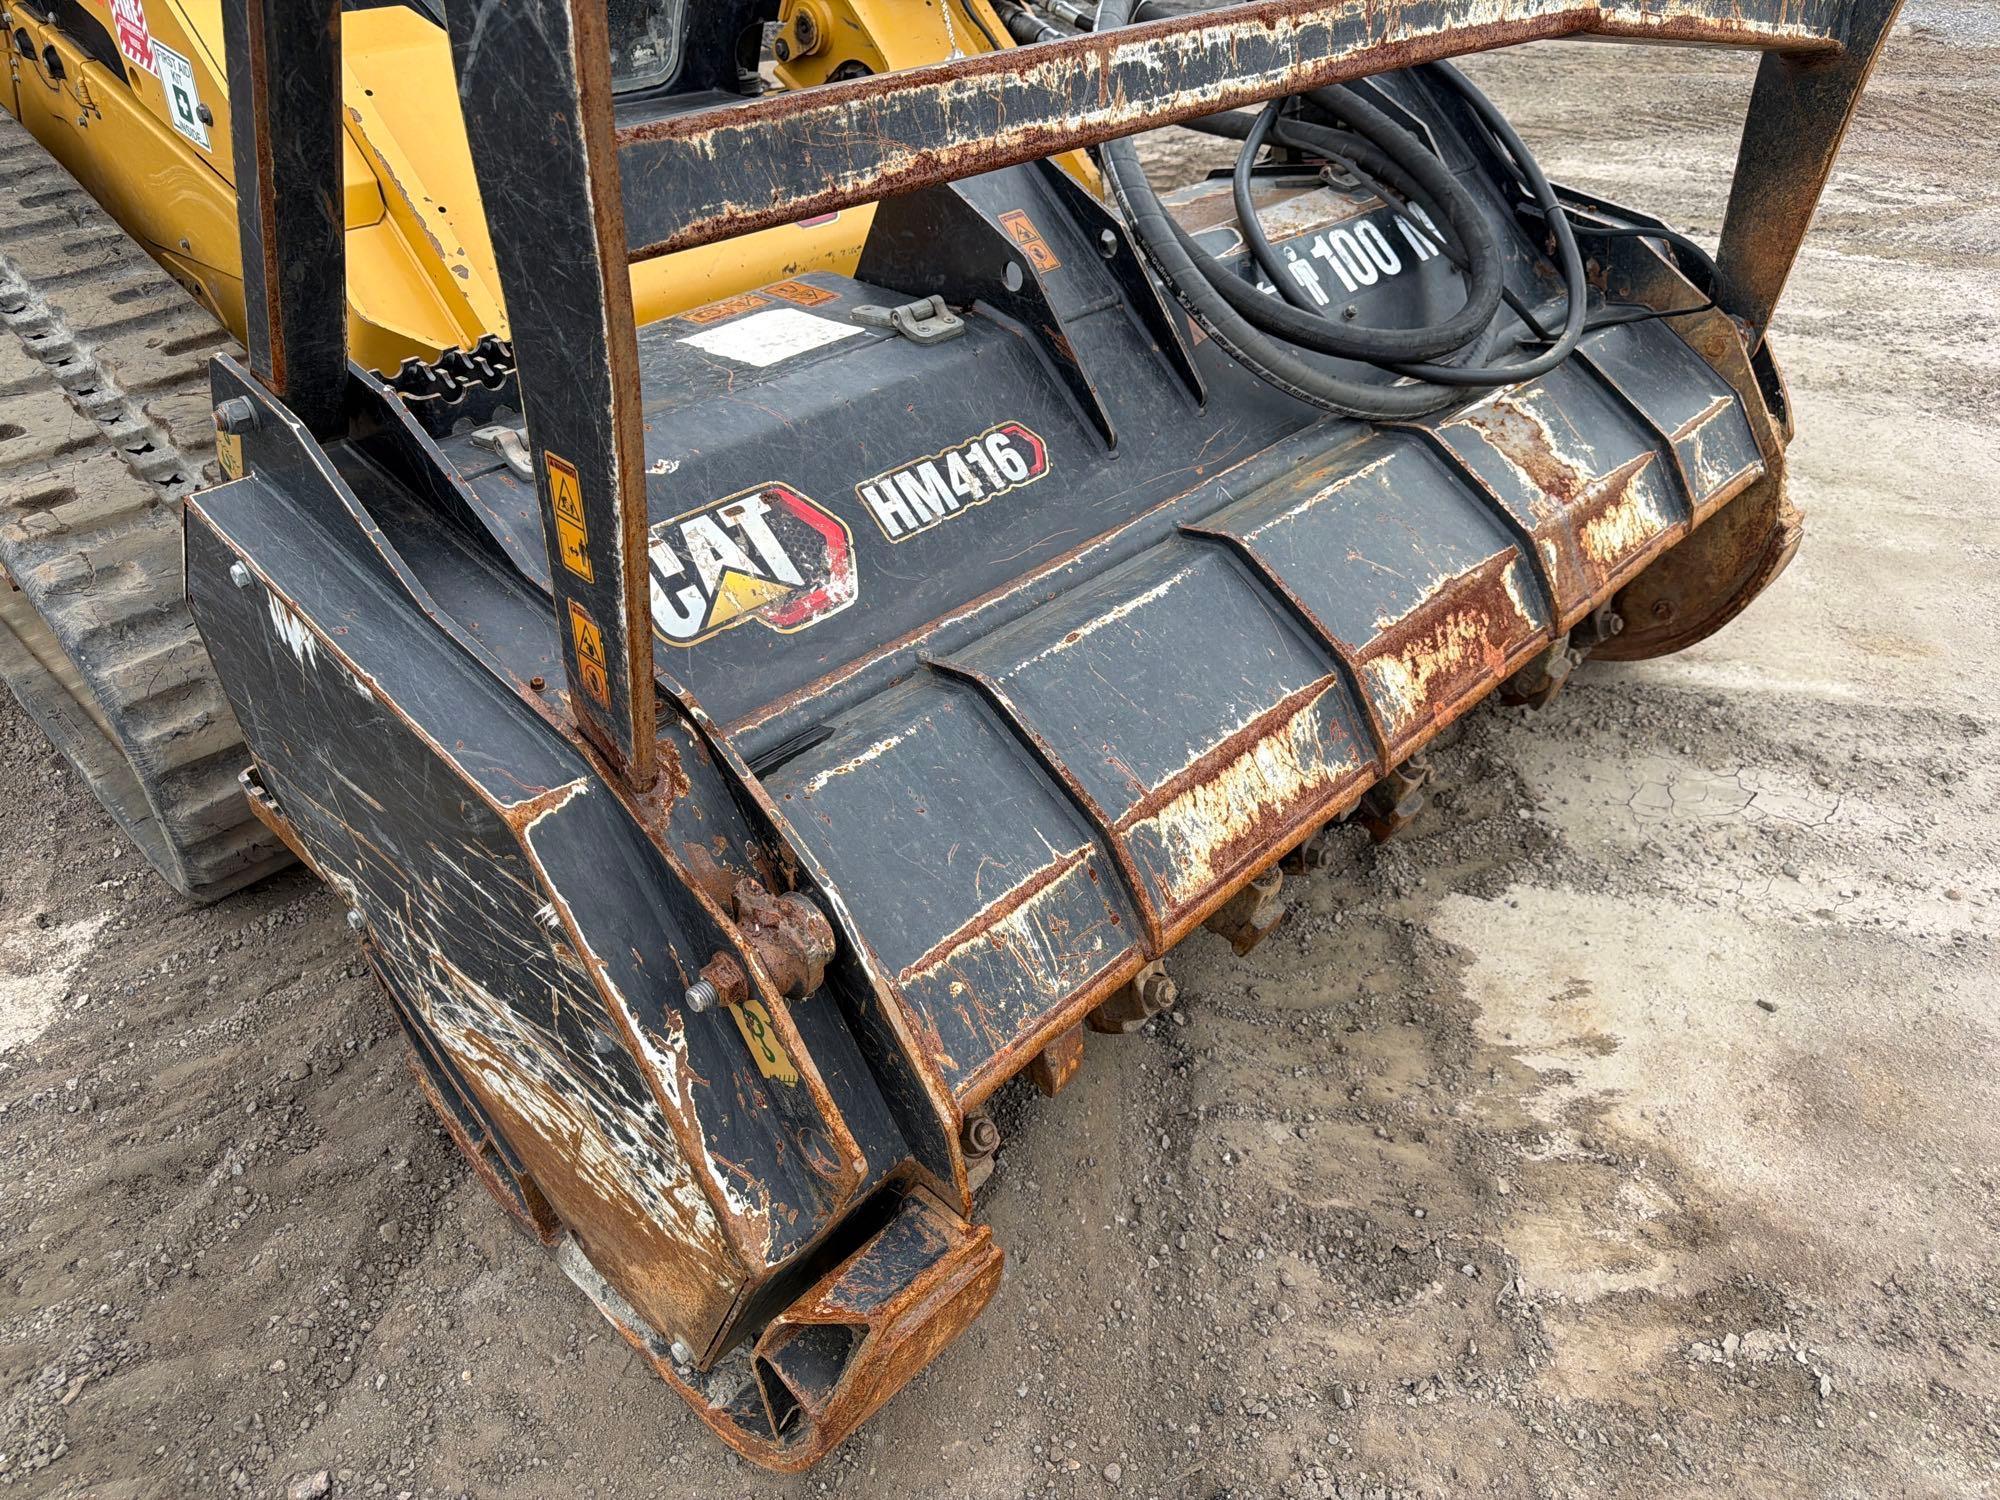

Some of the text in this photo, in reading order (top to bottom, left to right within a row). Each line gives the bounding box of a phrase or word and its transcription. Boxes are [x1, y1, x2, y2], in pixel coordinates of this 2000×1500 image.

[156, 48, 190, 78] FIRST AID
[170, 69, 182, 86] KIT
[1310, 219, 1402, 293] 100
[862, 433, 1029, 538] HM416
[648, 493, 805, 638] CAT
